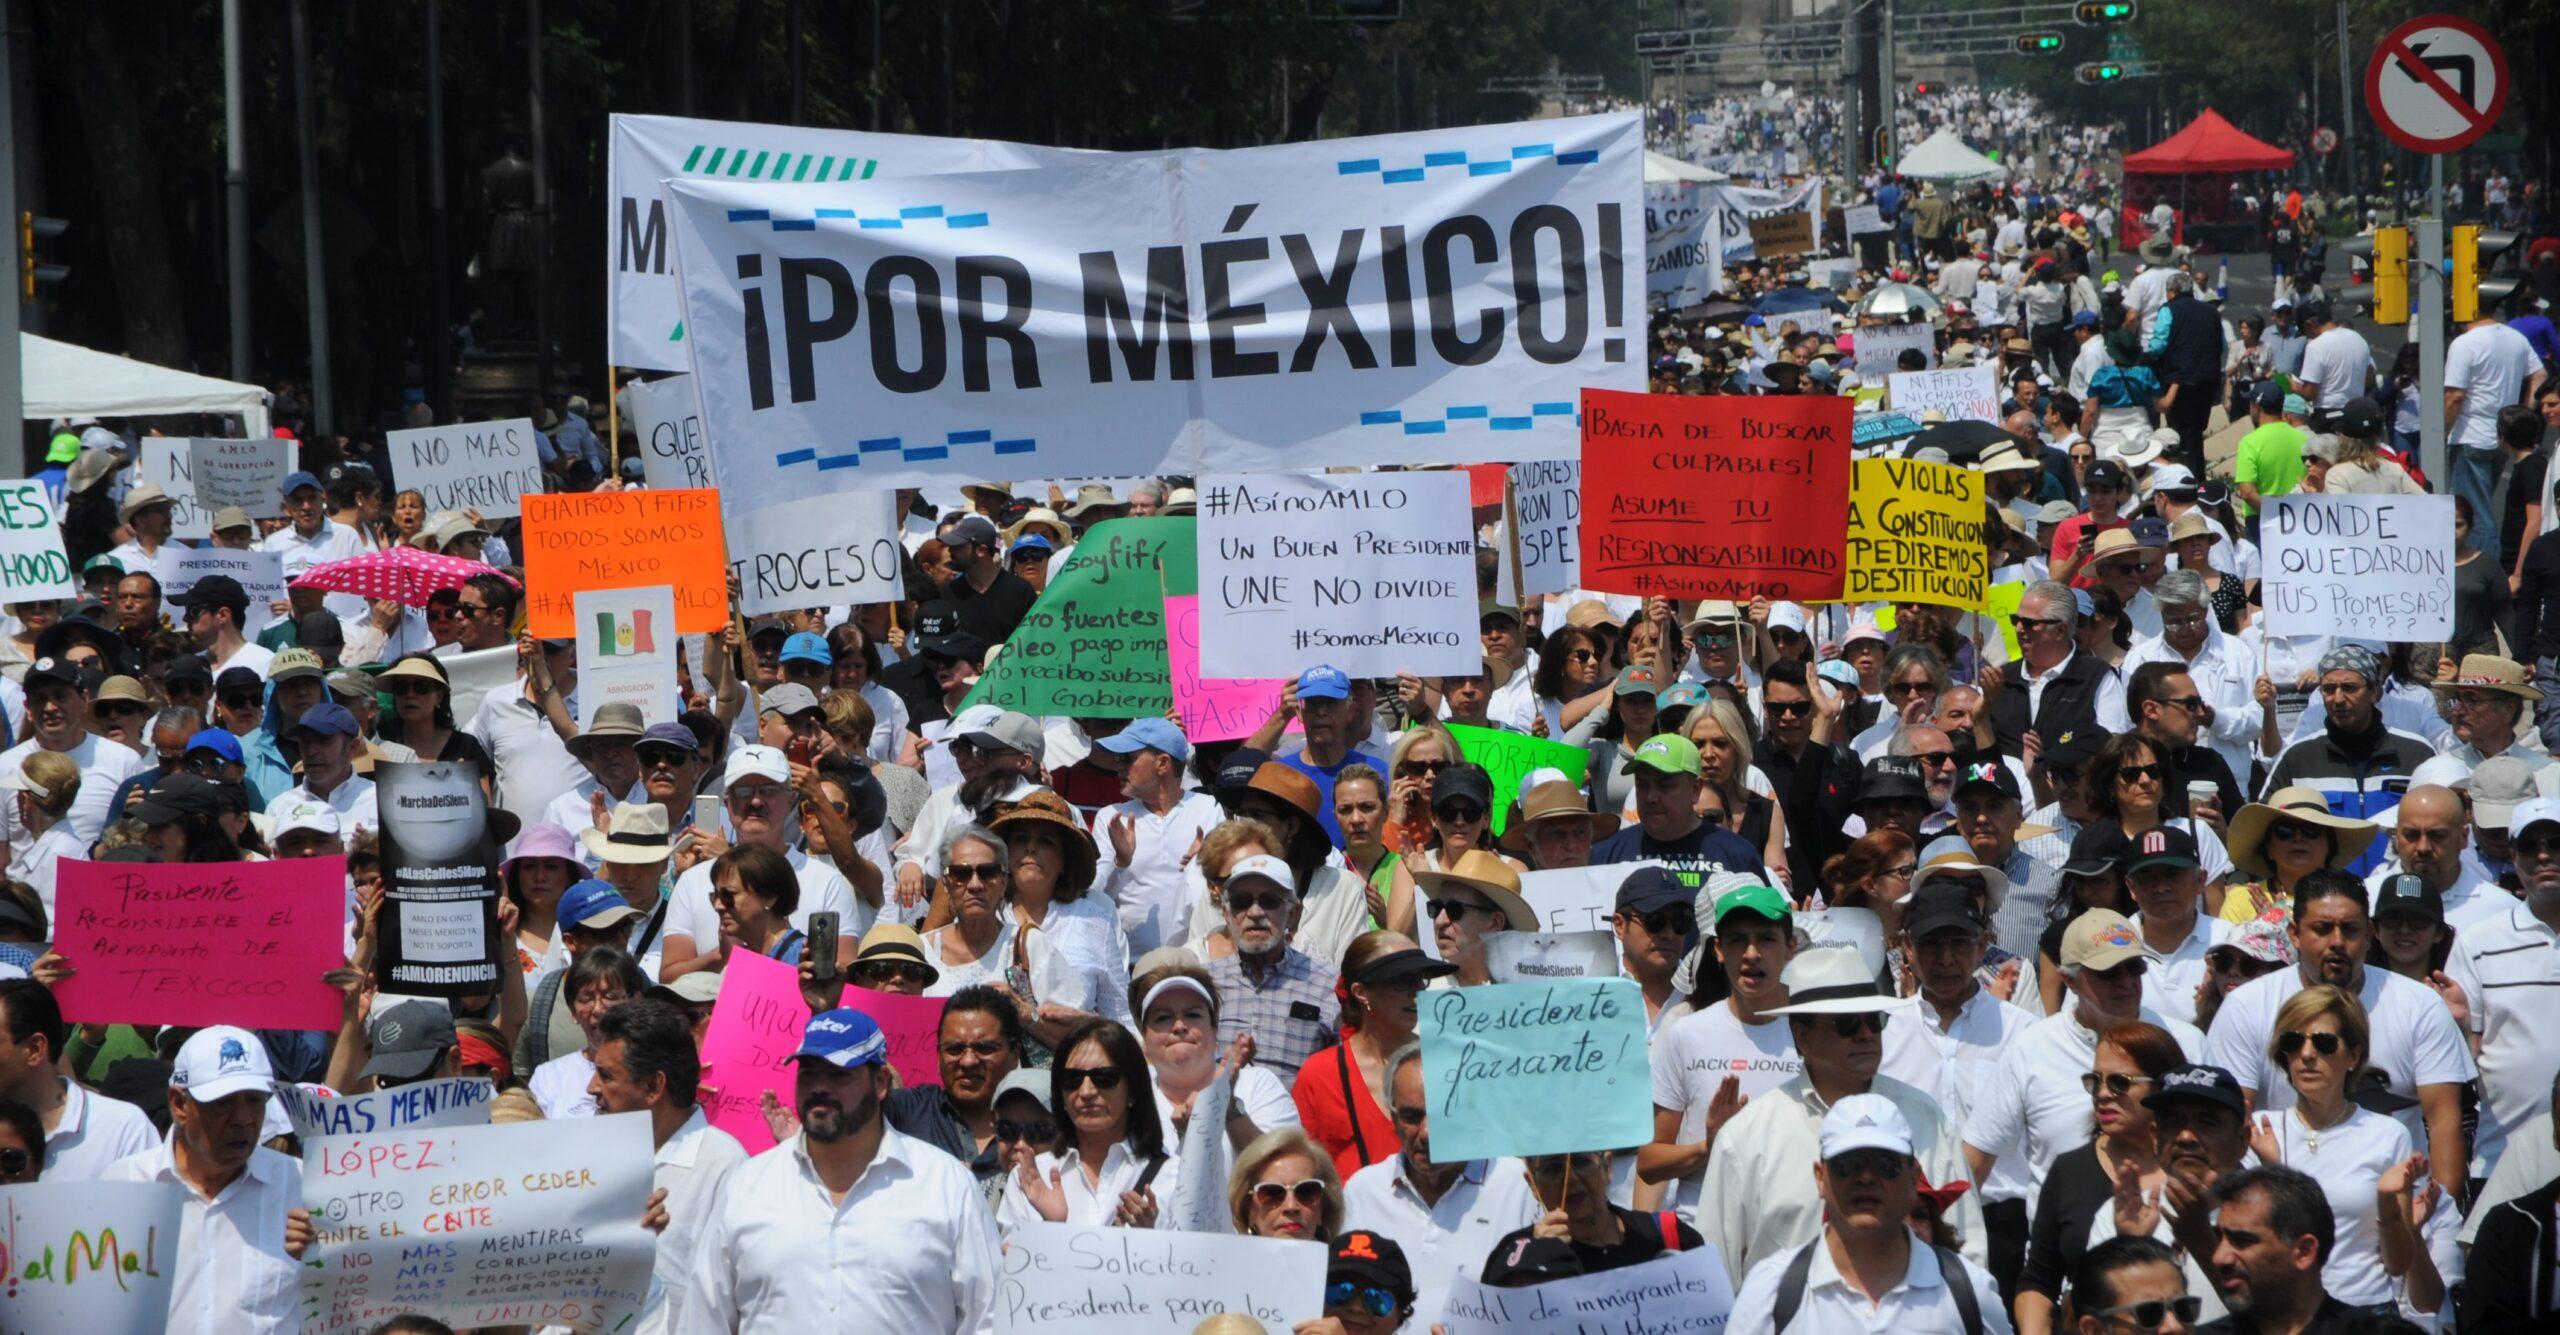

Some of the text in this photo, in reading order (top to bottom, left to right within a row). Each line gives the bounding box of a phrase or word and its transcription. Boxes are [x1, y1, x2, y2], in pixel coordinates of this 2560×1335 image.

[620, 196, 674, 275] M
[736, 201, 1627, 411] ¡POR MÉXICO!
[1583, 399, 1836, 443] ¡BASTA DE BUSCAR
[411, 428, 522, 468] NO MAS
[1652, 449, 1816, 485] CULPABLES!
[408, 466, 543, 513] CURRENCIAS
[1884, 460, 1970, 502] VIOLAS
[0, 486, 49, 530] ES
[529, 495, 625, 523] CHAIROS
[634, 495, 647, 518] Y
[1517, 490, 1551, 527] RON
[1611, 493, 1771, 518] ASUME TU
[1877, 497, 1986, 546] CONSTITUCION
[2278, 501, 2399, 540] DONDE
[534, 521, 705, 549] TODOS SOMOS
[1273, 535, 1338, 558] BUEN
[1354, 529, 1474, 556] PRESIDENTE
[1520, 525, 1580, 568] SPE
[1599, 533, 1837, 571] RESPONSABILIDAD
[1, 550, 71, 588] HOOD
[578, 555, 661, 581] MÉXICO
[732, 538, 897, 601] TROCESO
[1058, 535, 1167, 585] soyfifí
[1847, 537, 1986, 579] PEDIREMOS
[2280, 544, 2446, 576] QUEDARON
[1222, 575, 1460, 609] UNE NO DIVIDE
[1849, 567, 1983, 602] DESTITUCION
[2267, 581, 2318, 614] TUS
[1062, 599, 1159, 633] fuentes
[1070, 635, 1124, 666] pago
[1020, 663, 1095, 682] recibo
[974, 685, 1026, 707] del
[267, 906, 294, 927] EL
[237, 938, 280, 956] DE
[118, 967, 288, 998] TEXCOCO
[391, 962, 497, 984] #AMLORENUNCIA
[1514, 961, 1584, 978] #MarchaDelSilencio
[1433, 982, 1620, 1038] Presidente
[1444, 1029, 1631, 1118] farsante!
[1685, 1058, 1730, 1071] JACK
[309, 1097, 376, 1136] MAS
[390, 1078, 493, 1127] MENTIRAS
[323, 1140, 456, 1179] LÓPEZ:
[326, 1168, 597, 1222] OTRO ERROR CEDER
[313, 1223, 371, 1246] ANTE
[380, 1221, 405, 1238] EL
[342, 1227, 584, 1269] NO MAS MENTIRAS
[338, 1246, 611, 1286] NO MAS CORRUPCION
[1068, 1231, 1216, 1279] Solicita:
[395, 1278, 446, 1291] MAS
[471, 1266, 607, 1286] TRAICIONES
[476, 1303, 608, 1328] UNIDOS
[1001, 1278, 1151, 1329] Presidente
[1245, 1293, 1284, 1323] los
[1446, 1288, 1511, 1326] andil
[1529, 1282, 1561, 1322] de
